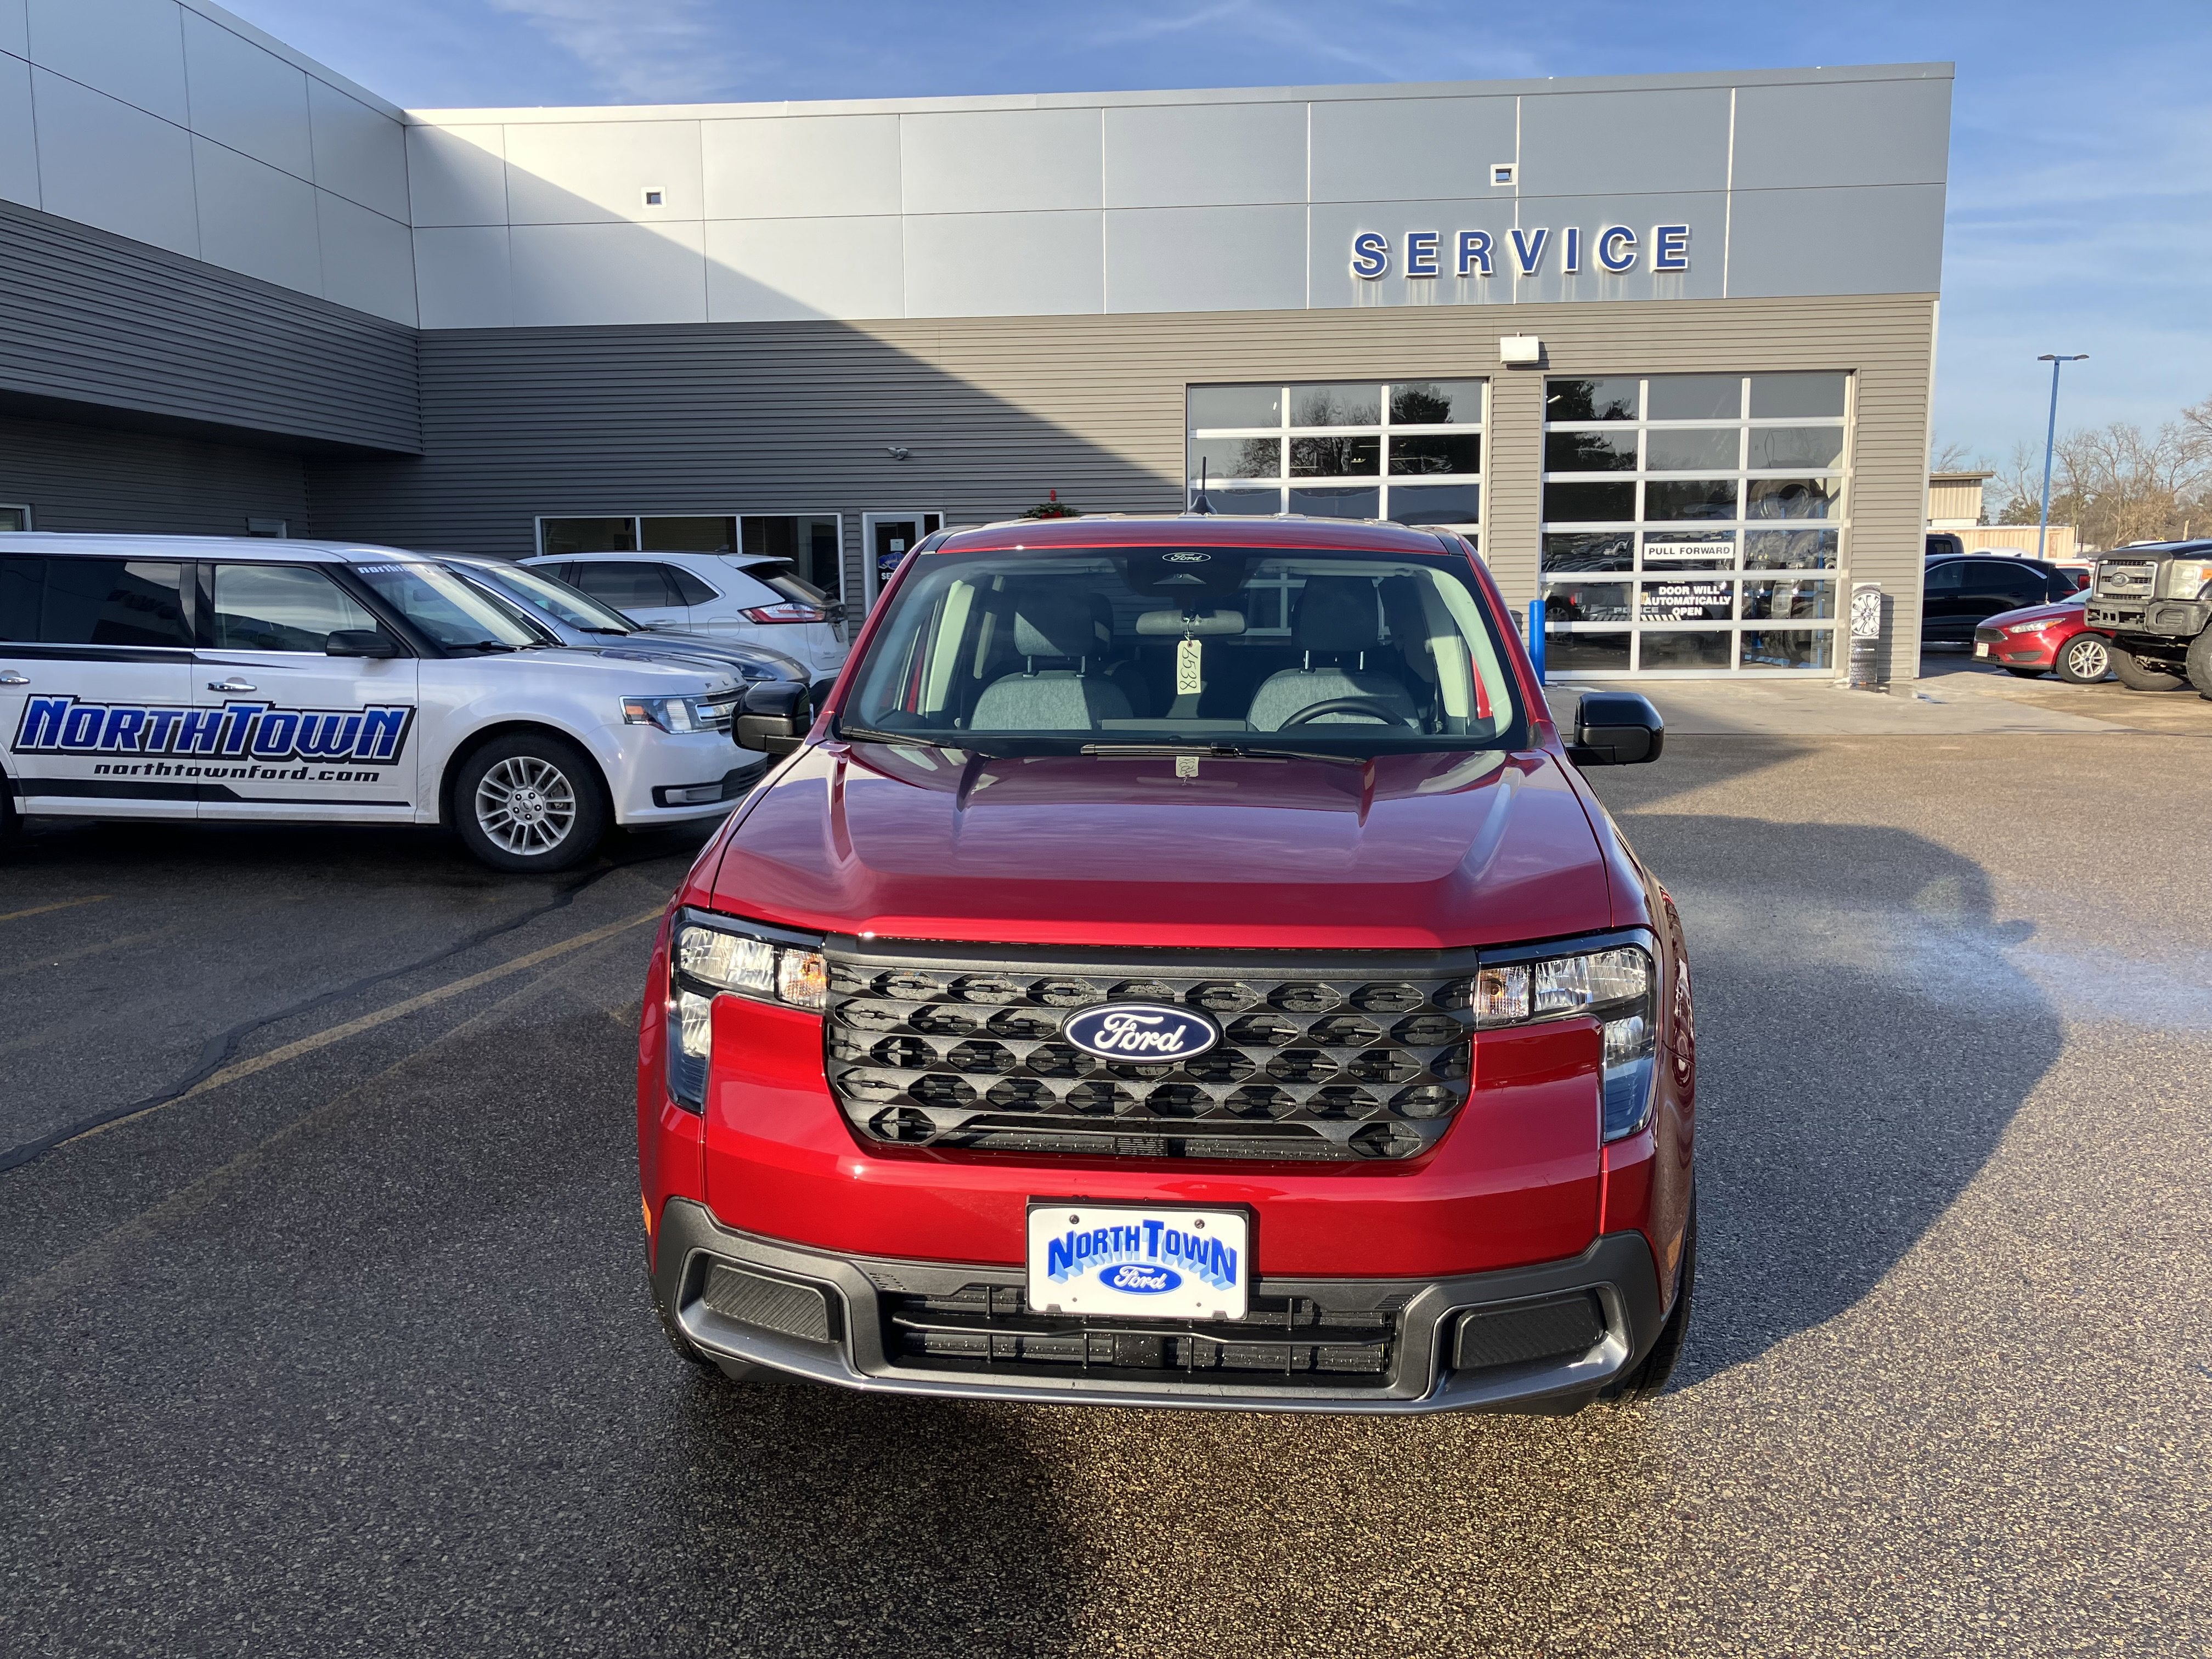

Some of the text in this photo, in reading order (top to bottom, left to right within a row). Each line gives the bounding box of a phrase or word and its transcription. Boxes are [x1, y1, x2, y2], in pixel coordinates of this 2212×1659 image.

[1351, 223, 1690, 278] SERVICE
[1679, 546, 1730, 555] FORWARD
[1658, 585, 1720, 595] DOOR WILL
[1644, 596, 1731, 606] AUTOMATICALLY
[1672, 606, 1703, 616] OPEN
[1179, 646, 1199, 690] 6538
[94, 762, 380, 783] northtownford.com
[1094, 1013, 1187, 1052] Ford
[1113, 1265, 1167, 1290] Ford
